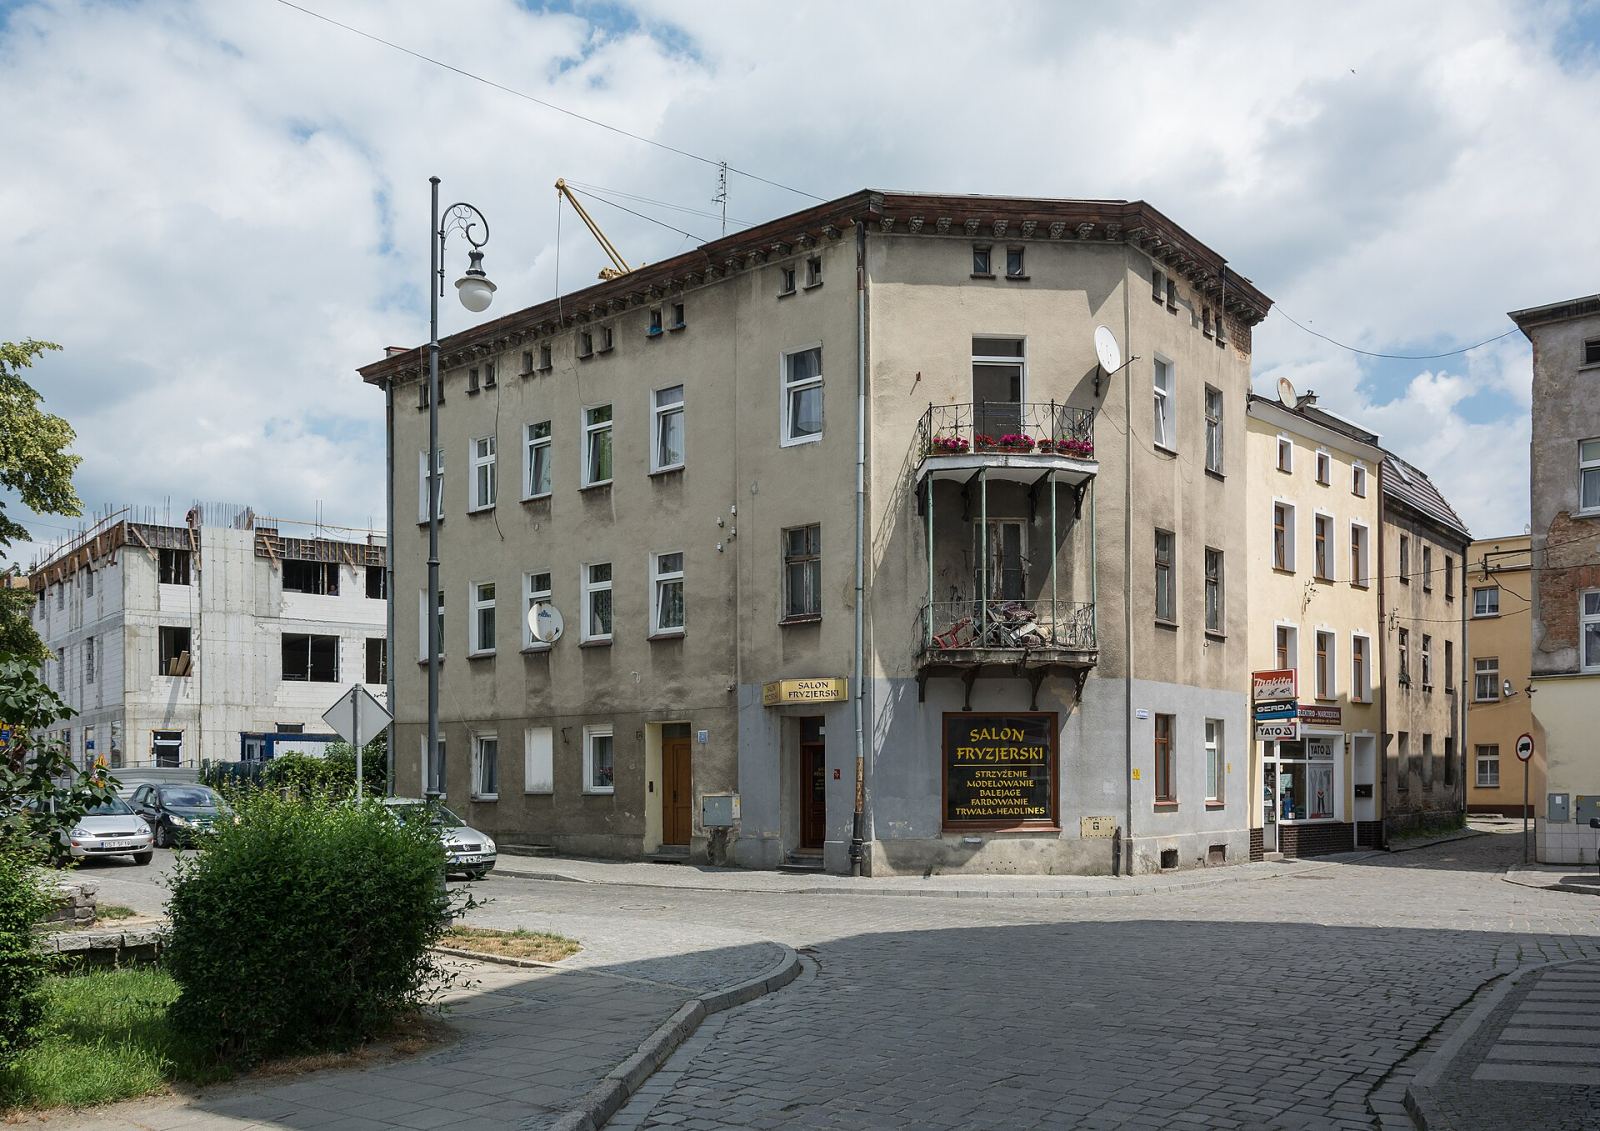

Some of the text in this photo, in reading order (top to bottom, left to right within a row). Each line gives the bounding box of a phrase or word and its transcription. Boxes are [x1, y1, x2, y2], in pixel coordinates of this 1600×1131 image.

[798, 681, 829, 689] SALON
[788, 690, 839, 698] FRYZJERSKI
[1256, 704, 1292, 713] GERDA
[969, 727, 1025, 742] SALON
[1259, 727, 1282, 736] YATO
[1310, 744, 1325, 755] YATO
[956, 747, 1043, 762] FRYZJERSKI
[966, 780, 1035, 788] MODELOWANIE
[979, 789, 1021, 797] BALEJAGE
[970, 798, 1029, 806] FARBOWANIE
